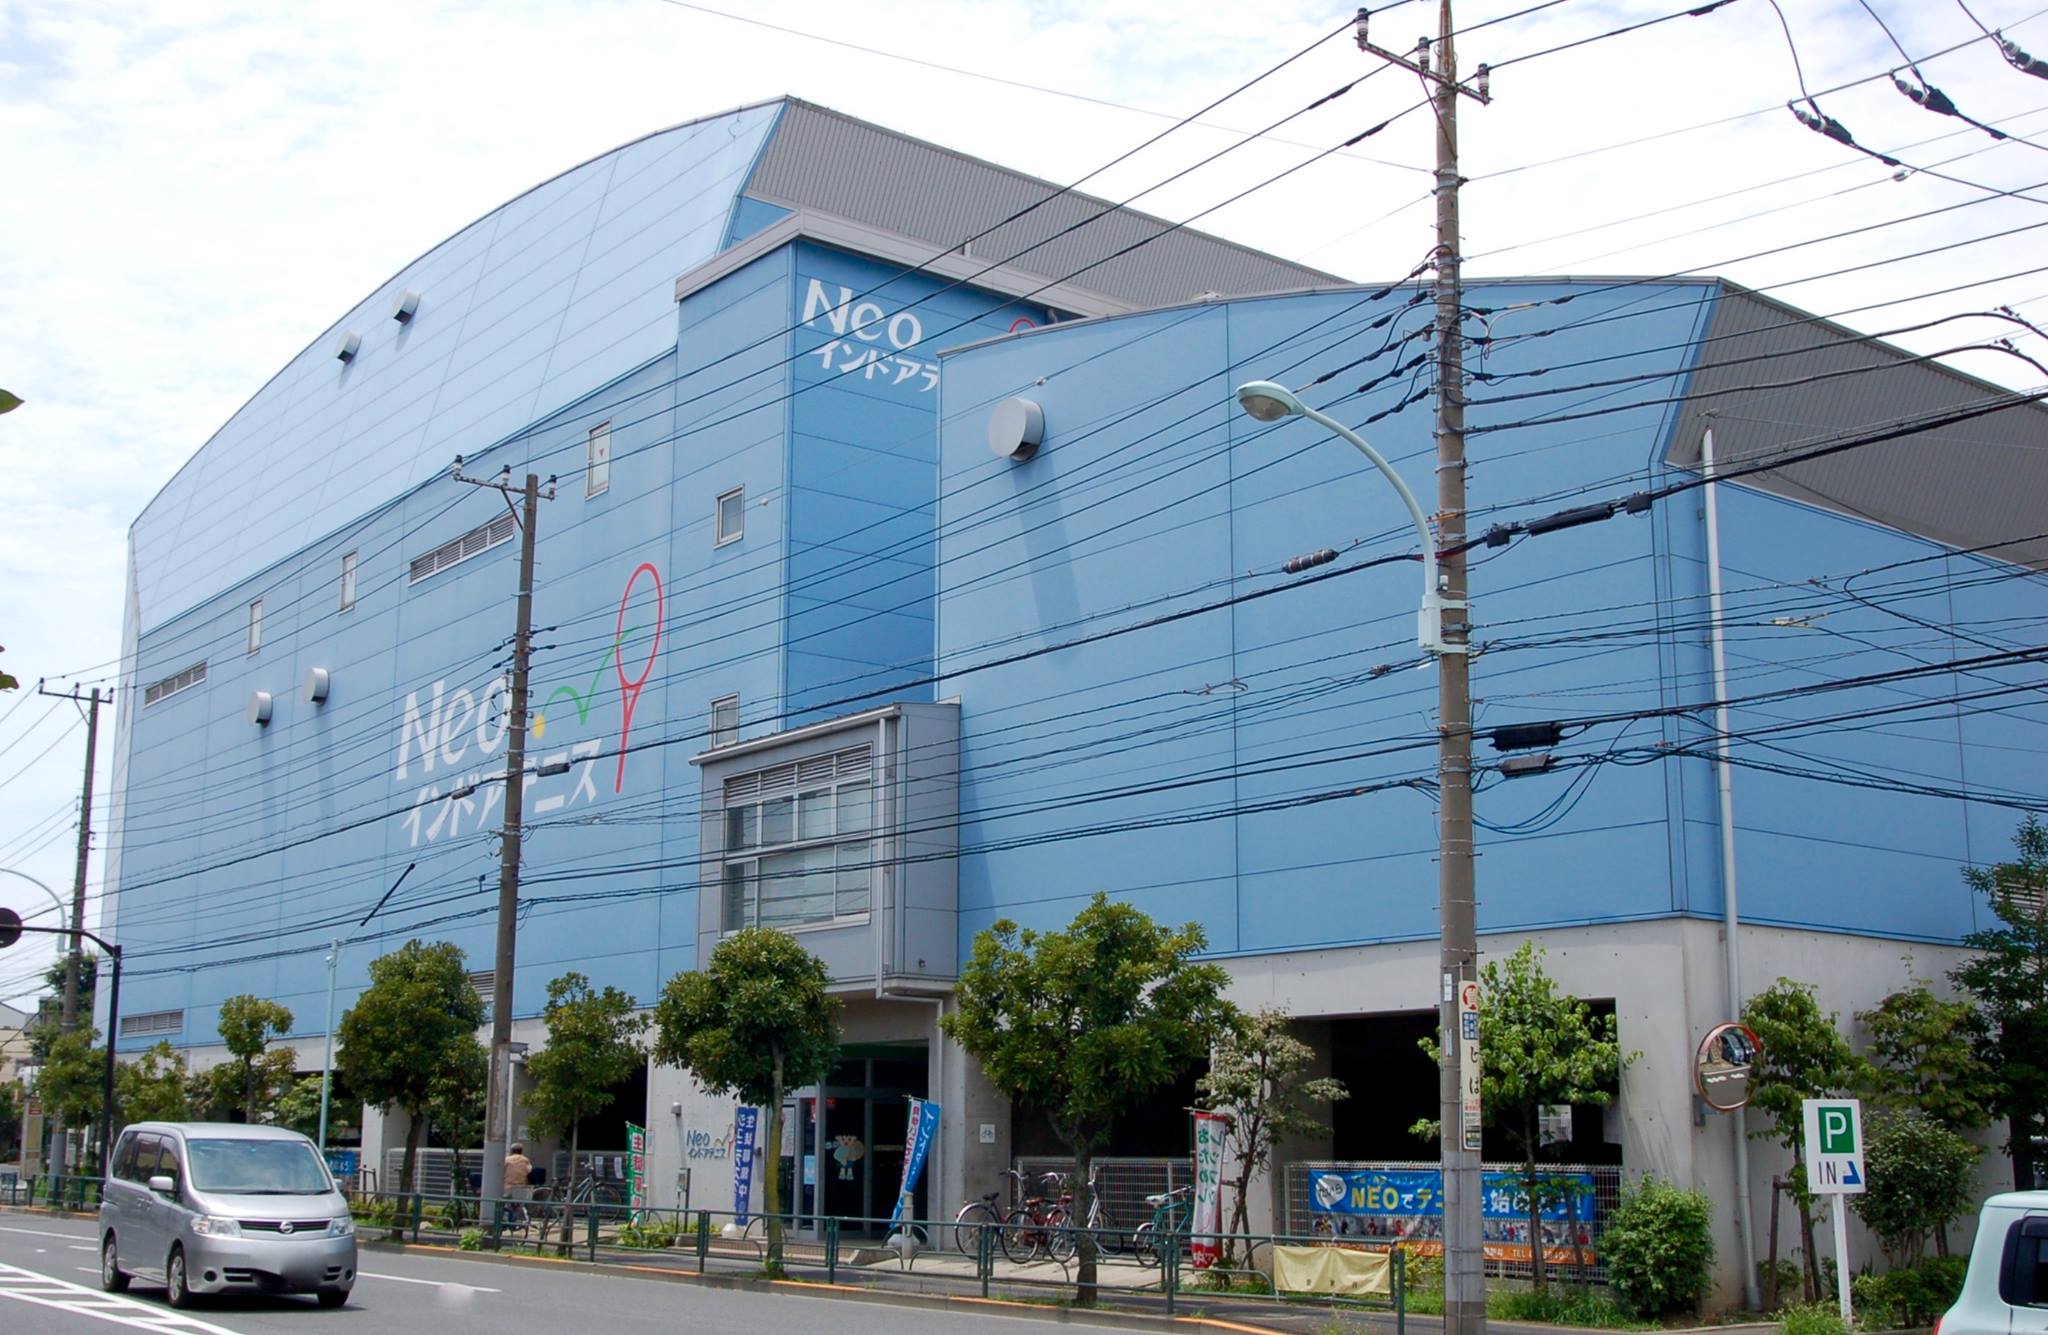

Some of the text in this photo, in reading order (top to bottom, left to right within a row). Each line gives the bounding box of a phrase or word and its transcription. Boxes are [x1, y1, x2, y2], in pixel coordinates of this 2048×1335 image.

[802, 278, 922, 351] Neo
[396, 676, 514, 781] Neo
[686, 1129, 710, 1147] Neo
[1824, 1111, 1848, 1149] P
[1818, 1161, 1837, 1184] IN
